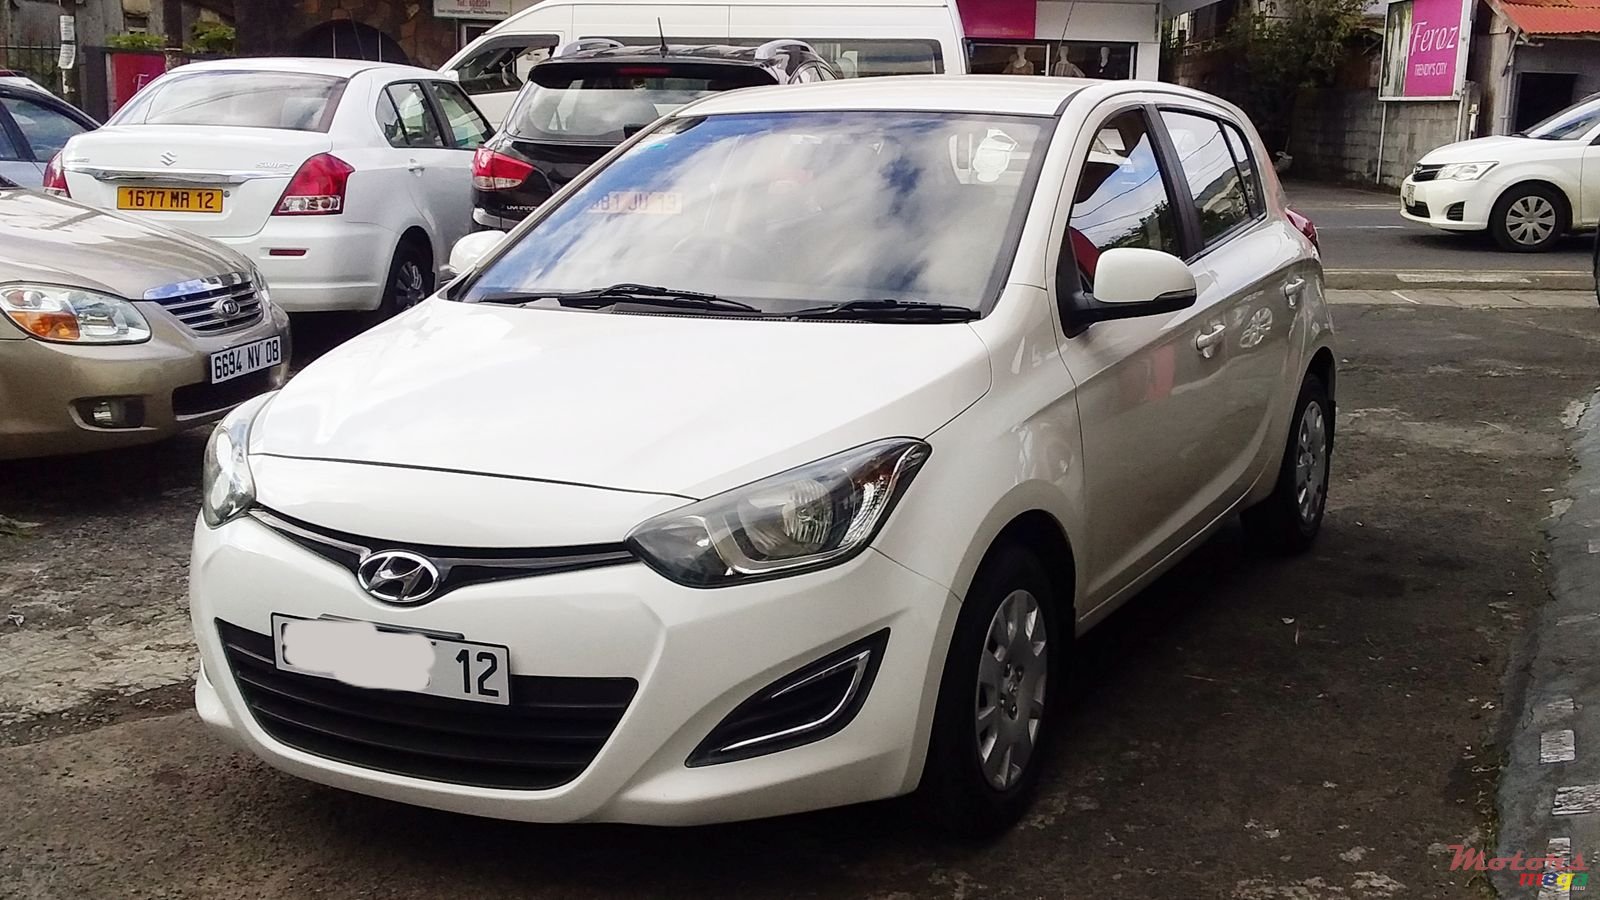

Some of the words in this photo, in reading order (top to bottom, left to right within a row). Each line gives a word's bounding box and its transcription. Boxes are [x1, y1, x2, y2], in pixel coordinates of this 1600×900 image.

[1410, 21, 1459, 56] Feroz
[1414, 63, 1436, 76] TRENDY'S
[1436, 62, 1448, 75] CITY
[127, 190, 165, 207] 1677
[197, 192, 214, 209] 12
[215, 350, 242, 379] 6694
[247, 343, 261, 370] NV
[265, 340, 279, 364] 08
[456, 649, 499, 697] 12
